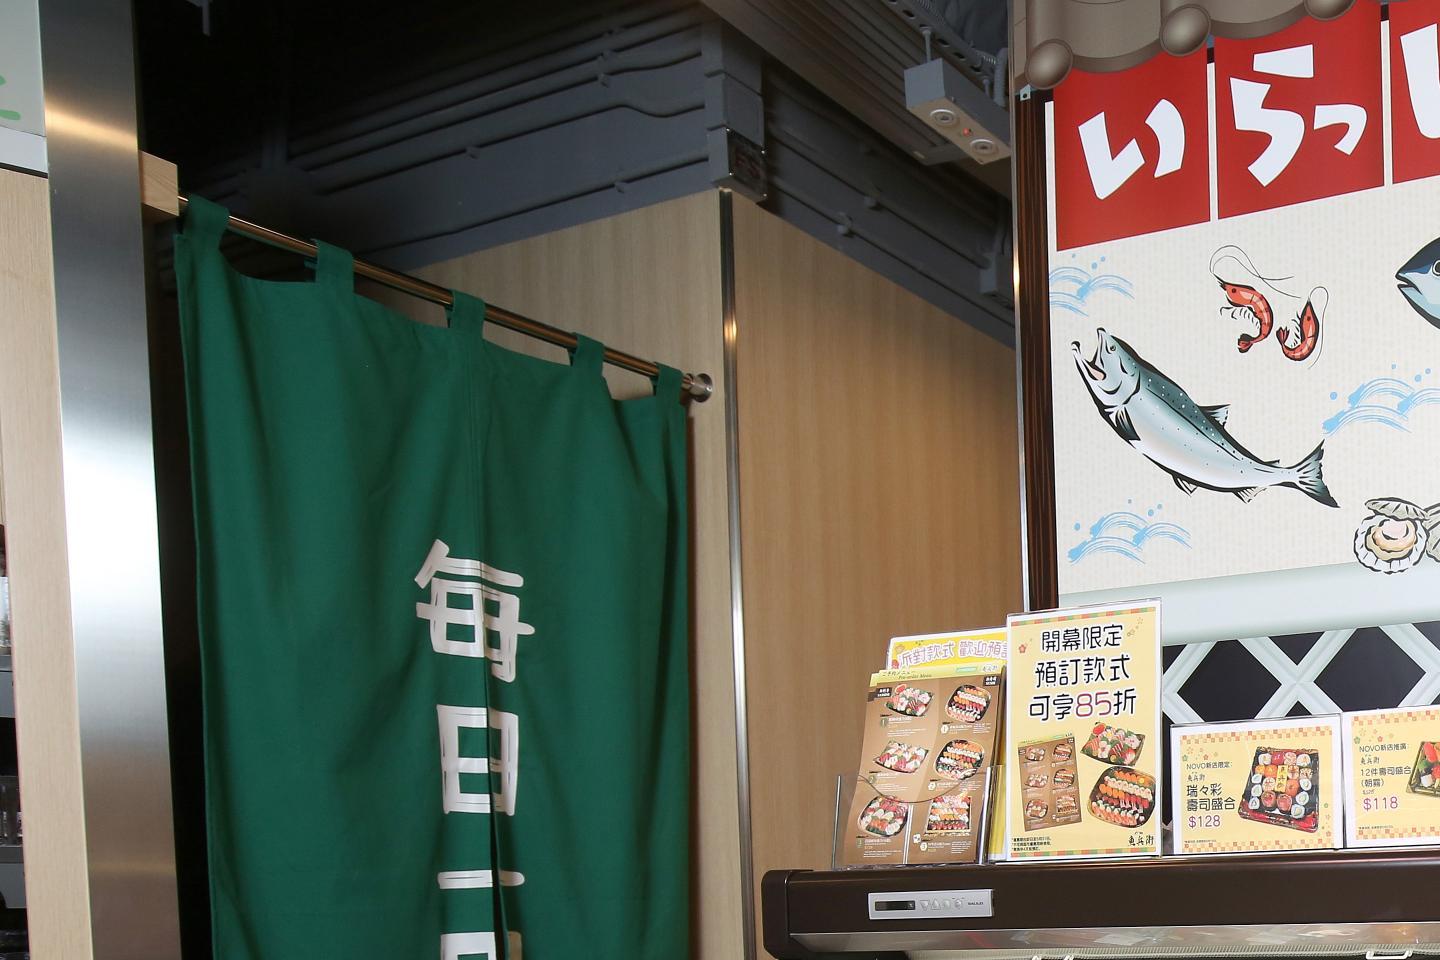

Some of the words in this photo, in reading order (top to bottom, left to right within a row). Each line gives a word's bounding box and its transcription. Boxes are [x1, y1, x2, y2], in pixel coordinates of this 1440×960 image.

[1042, 624, 1123, 653] 開幕限定
[1035, 654, 1130, 687] 預訂款式
[1029, 689, 1137, 720] 可享85折
[1363, 796, 1398, 811] $118
[1188, 814, 1221, 829] $128
